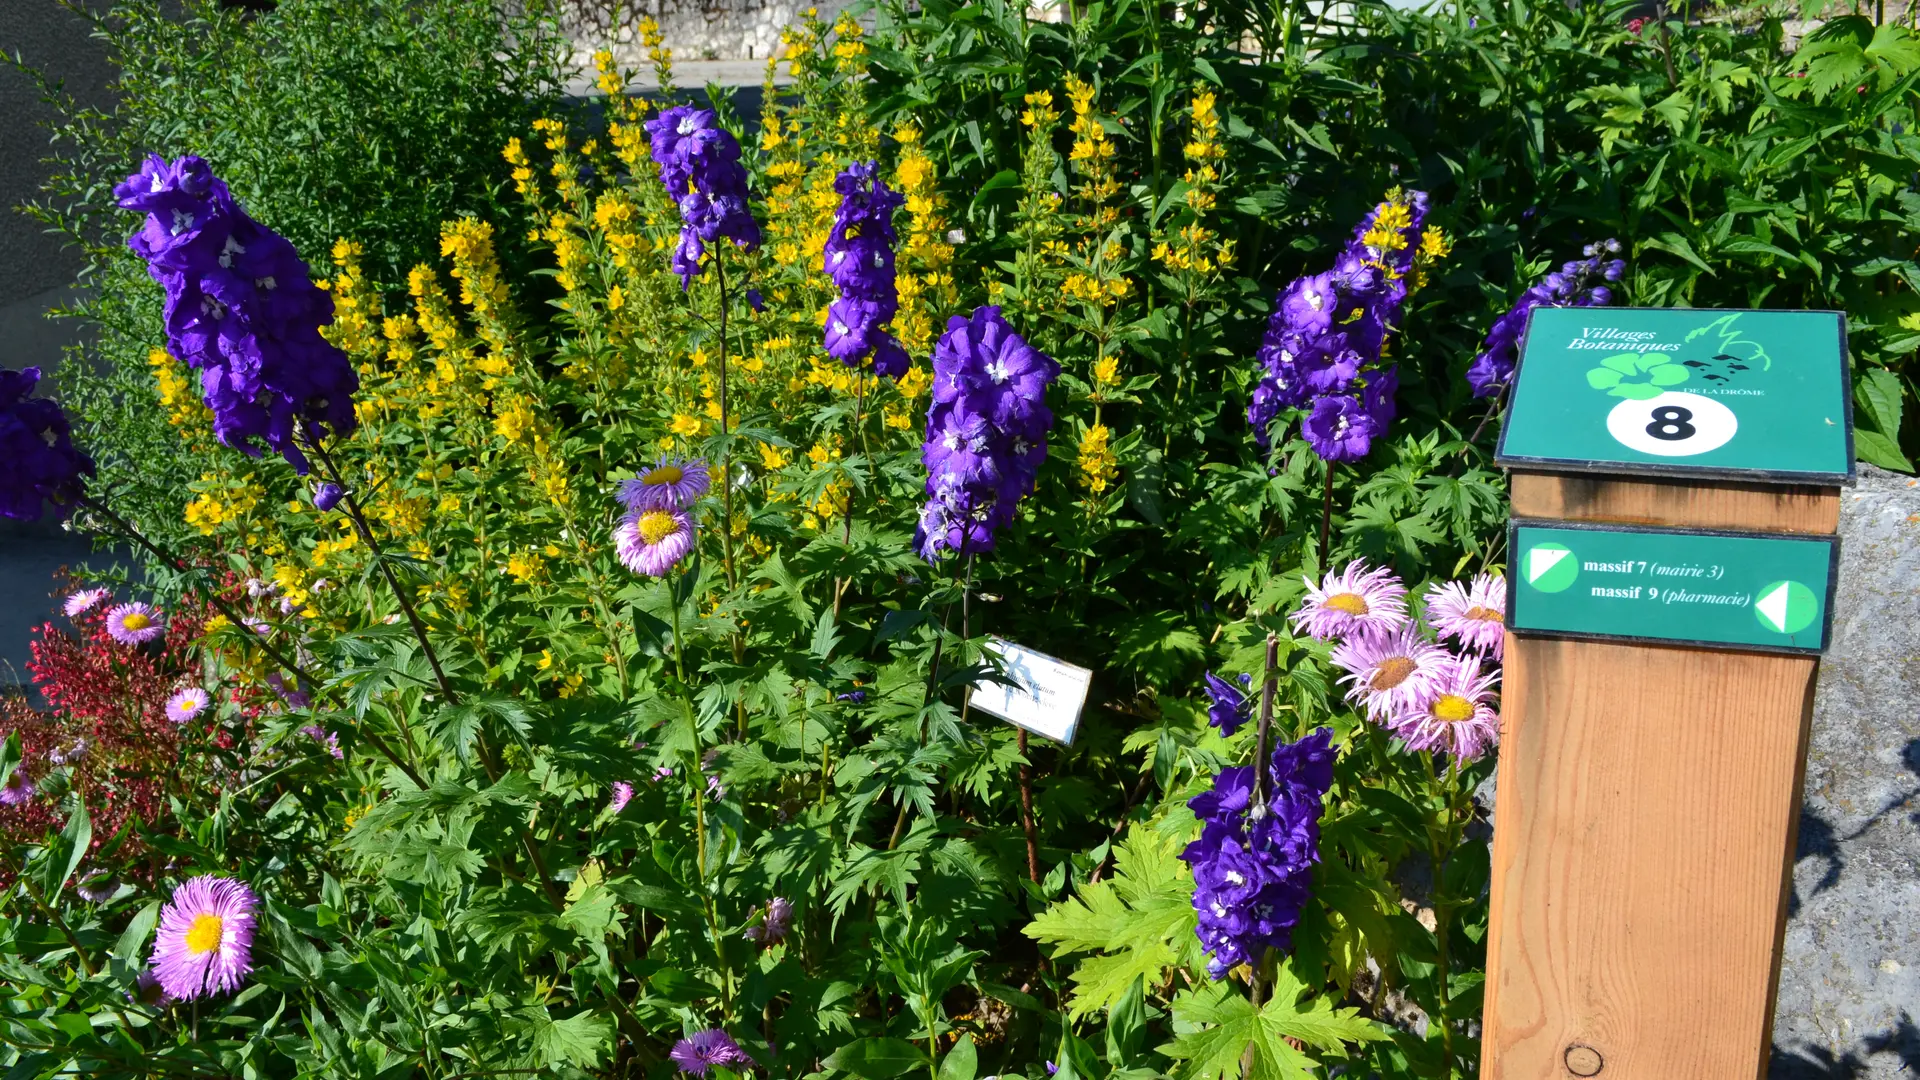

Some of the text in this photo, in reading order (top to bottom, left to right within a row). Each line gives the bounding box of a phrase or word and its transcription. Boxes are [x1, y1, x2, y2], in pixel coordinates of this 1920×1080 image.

[1582, 327, 1657, 342] Villages
[1566, 338, 1682, 354] Botaniques
[1720, 387, 1765, 396] DRÔME
[1646, 406, 1696, 441] 8
[1584, 560, 1725, 580] massif 7 (mairie 3)
[1591, 586, 1750, 607] massif 9 (pharmacie)
